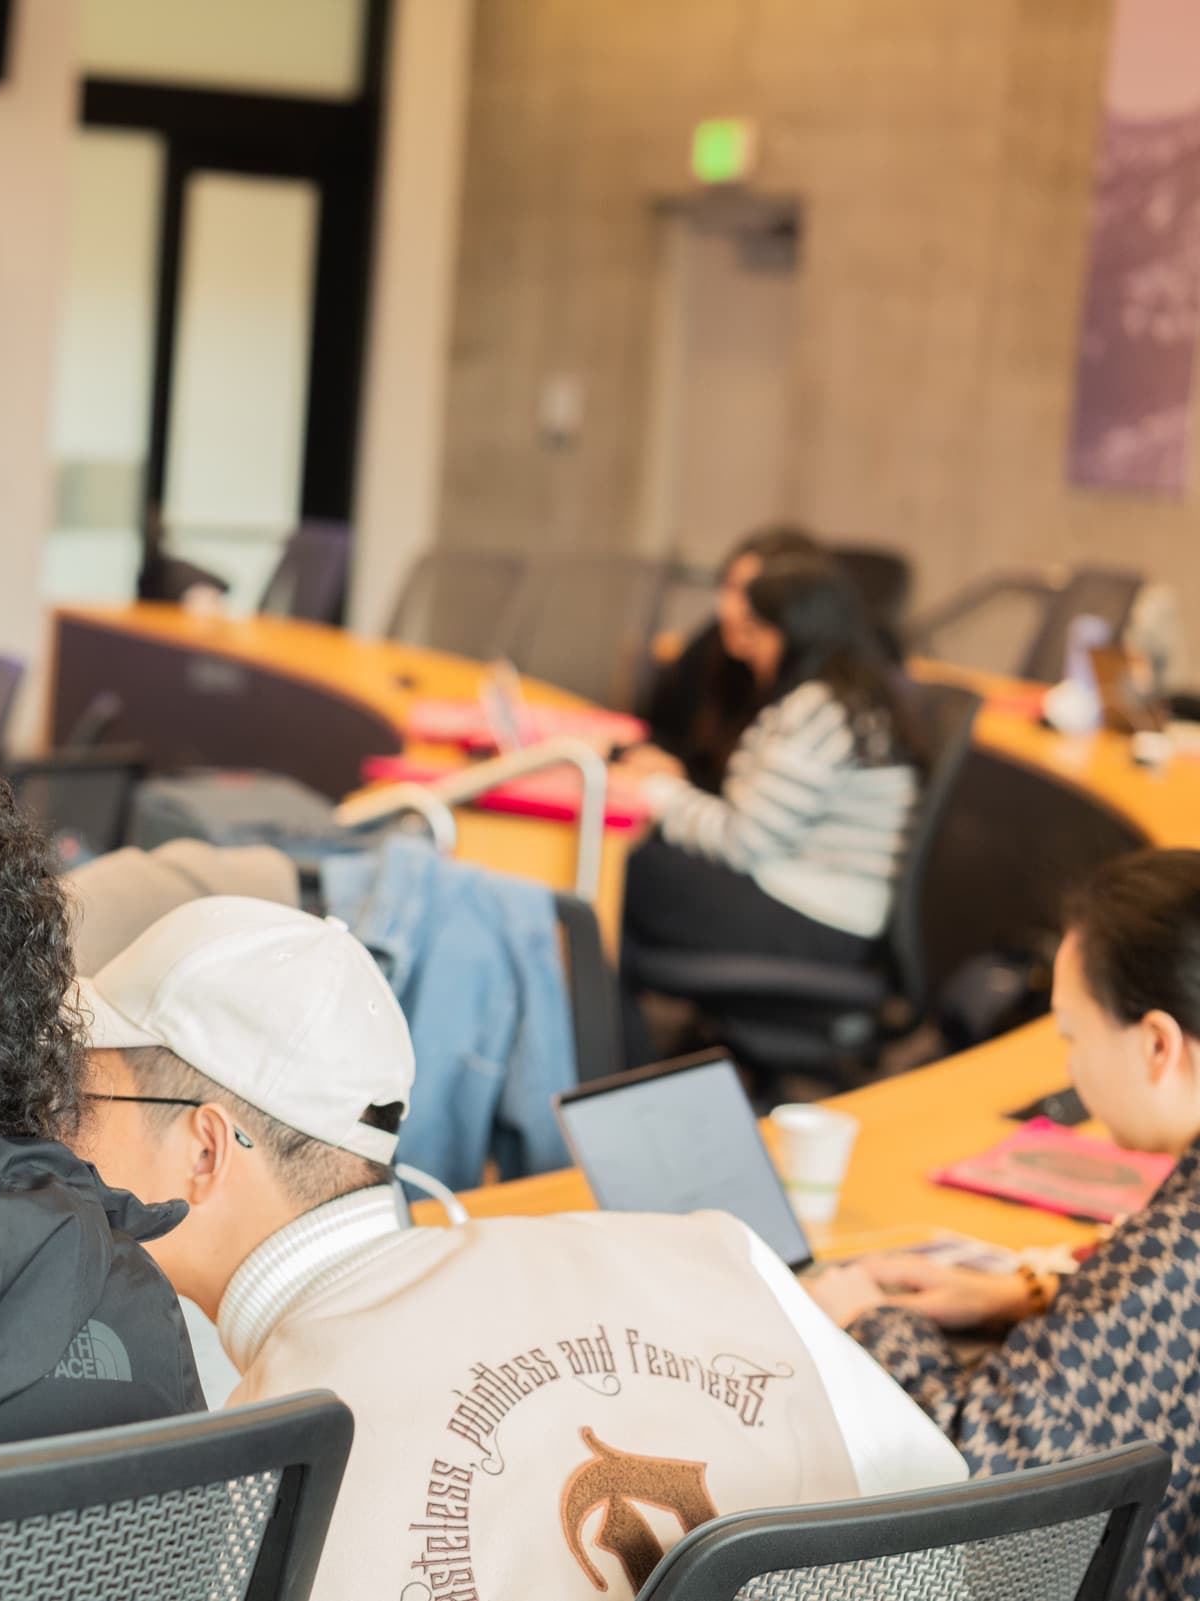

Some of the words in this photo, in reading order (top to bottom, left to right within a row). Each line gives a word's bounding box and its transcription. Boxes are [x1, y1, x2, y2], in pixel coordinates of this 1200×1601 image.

[46, 1358, 97, 1379] ACE
[407, 1459, 480, 1601] asteless,
[447, 1348, 561, 1458] pointless
[557, 1323, 620, 1385] and
